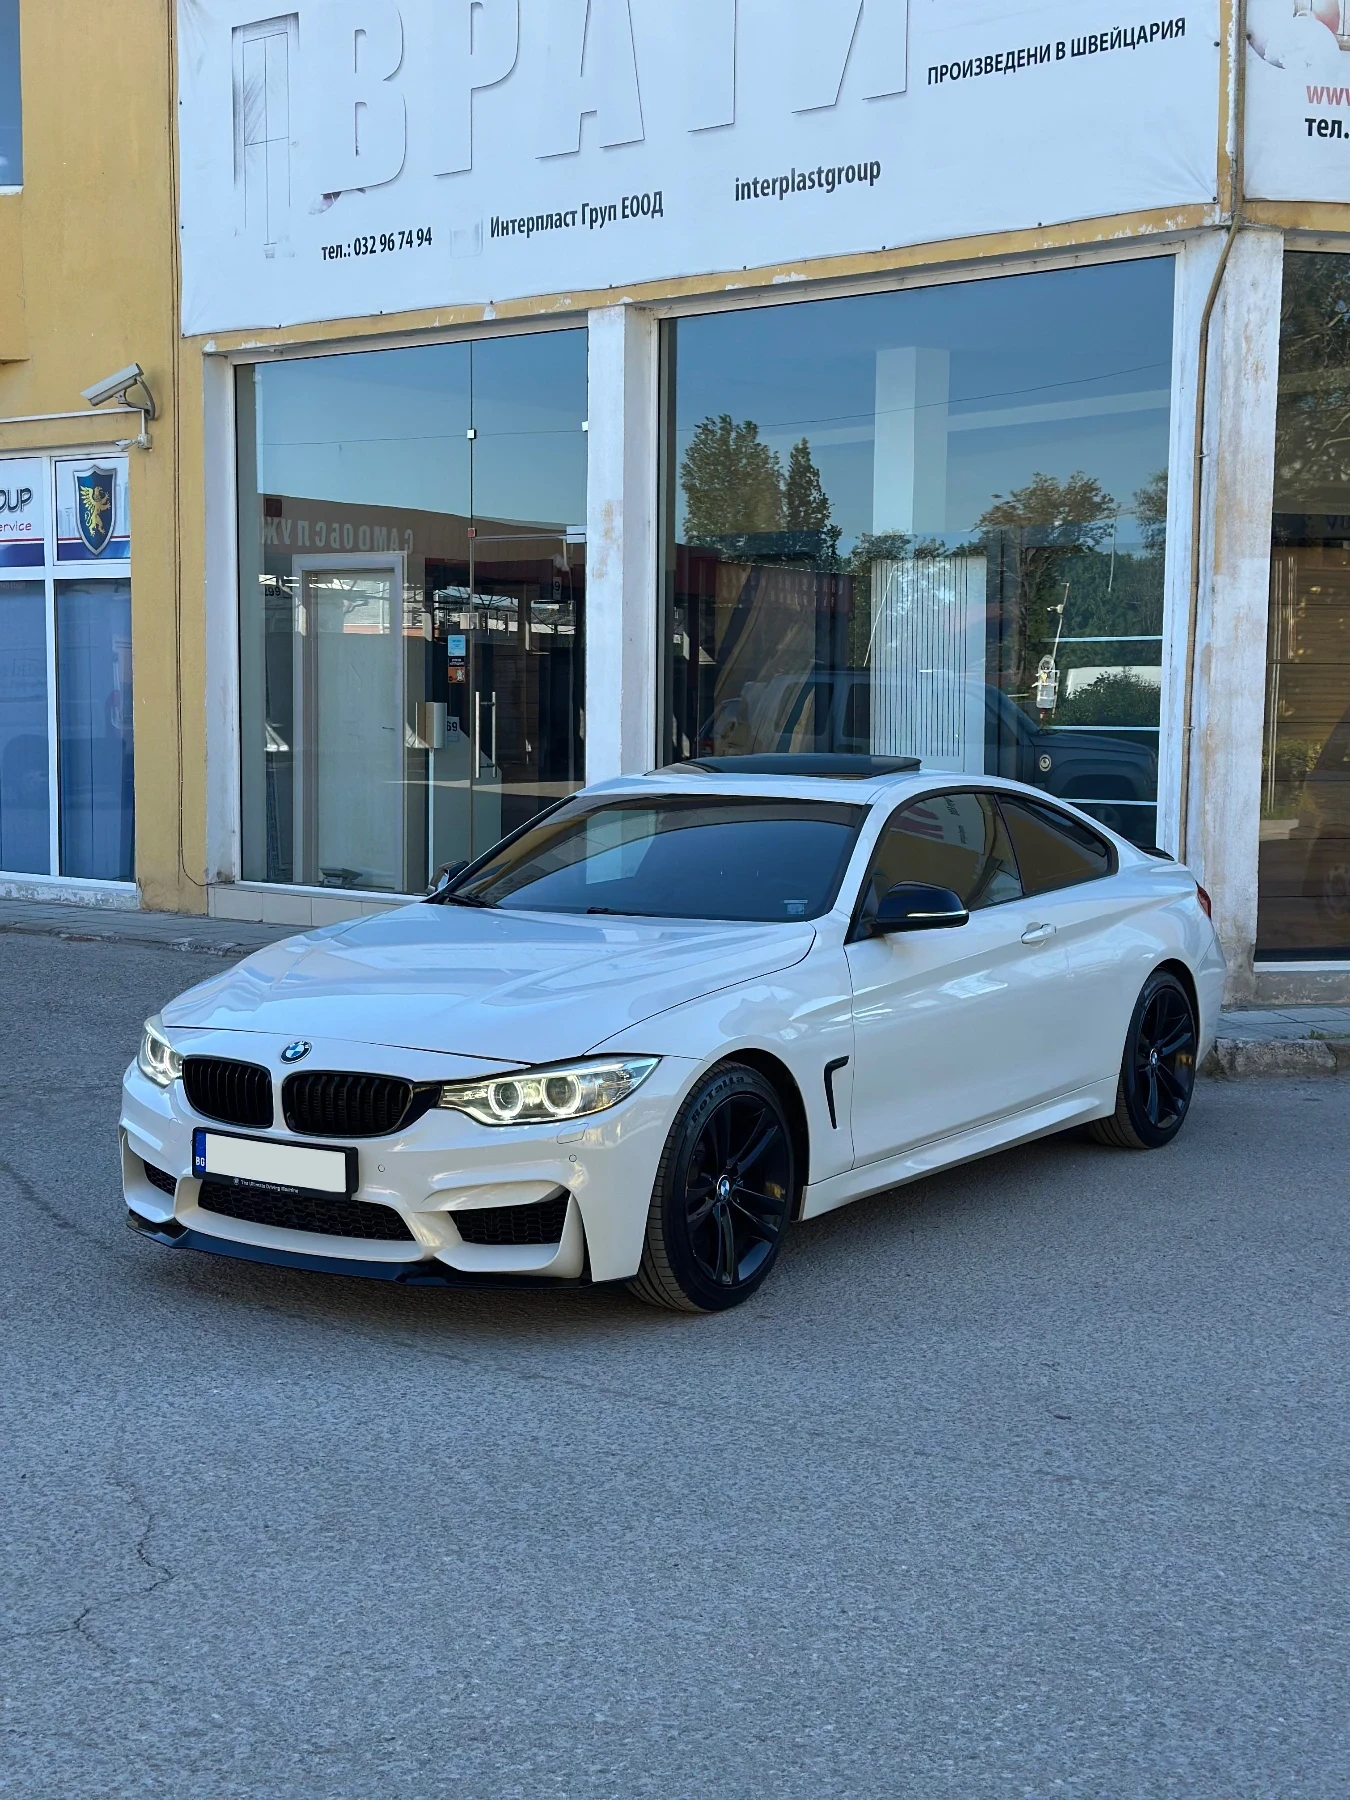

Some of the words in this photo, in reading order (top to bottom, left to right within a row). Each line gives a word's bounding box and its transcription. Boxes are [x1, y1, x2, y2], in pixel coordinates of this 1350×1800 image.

[927, 43, 1051, 86] ПРОИЗВЕДЕНИ
[1055, 41, 1066, 61] В
[1070, 17, 1186, 58] ШВЕЙЦАРИЯ
[1306, 85, 1350, 107] ww
[1304, 117, 1350, 139] тел.
[735, 161, 881, 203] interplastgroup
[491, 210, 578, 238] Интерпласт
[581, 202, 617, 230] Груп
[621, 190, 664, 220] ЕООД
[321, 243, 351, 261] тел.:
[354, 236, 377, 257] 032
[380, 231, 395, 253] 96
[398, 230, 414, 250] 74
[416, 227, 433, 248] 94
[195, 1156, 205, 1166] BG
